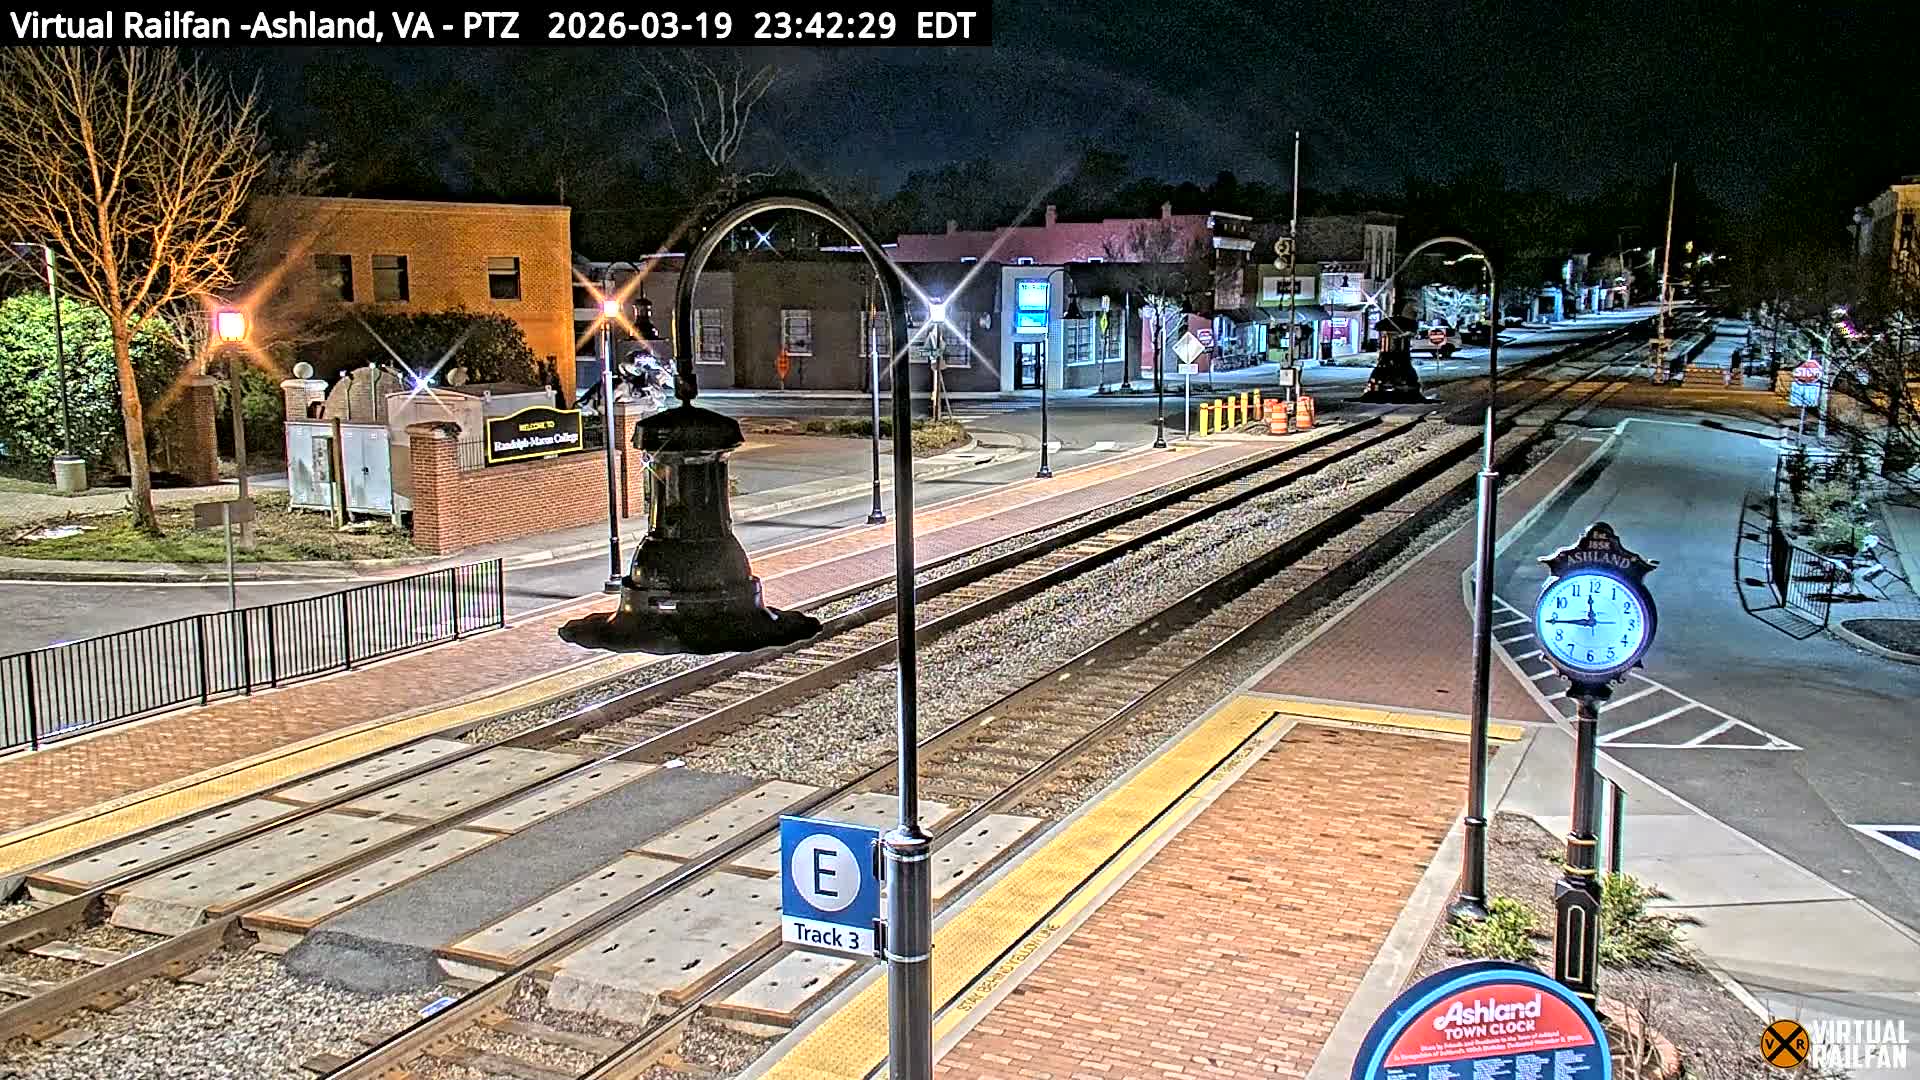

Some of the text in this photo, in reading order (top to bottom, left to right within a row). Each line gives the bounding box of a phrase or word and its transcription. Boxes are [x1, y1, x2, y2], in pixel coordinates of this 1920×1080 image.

[1794, 367, 1820, 377] STOP
[1567, 552, 1630, 568] ASHLAND
[1572, 584, 1580, 597] 11
[1590, 581, 1601, 593] 12
[1611, 588, 1616, 600] 1
[1556, 597, 1568, 609] 10
[1624, 602, 1631, 614] 2
[1628, 619, 1635, 631] 3
[1555, 629, 1564, 641] 8
[1621, 634, 1629, 647] 4
[1567, 643, 1575, 657] 7
[1586, 649, 1594, 662] 6
[1606, 646, 1615, 659] 5
[814, 848, 838, 897] E
[794, 922, 859, 949] Track 3
[1433, 992, 1541, 1031] Ashland
[1444, 1020, 1535, 1040] TOWN CLOCK
